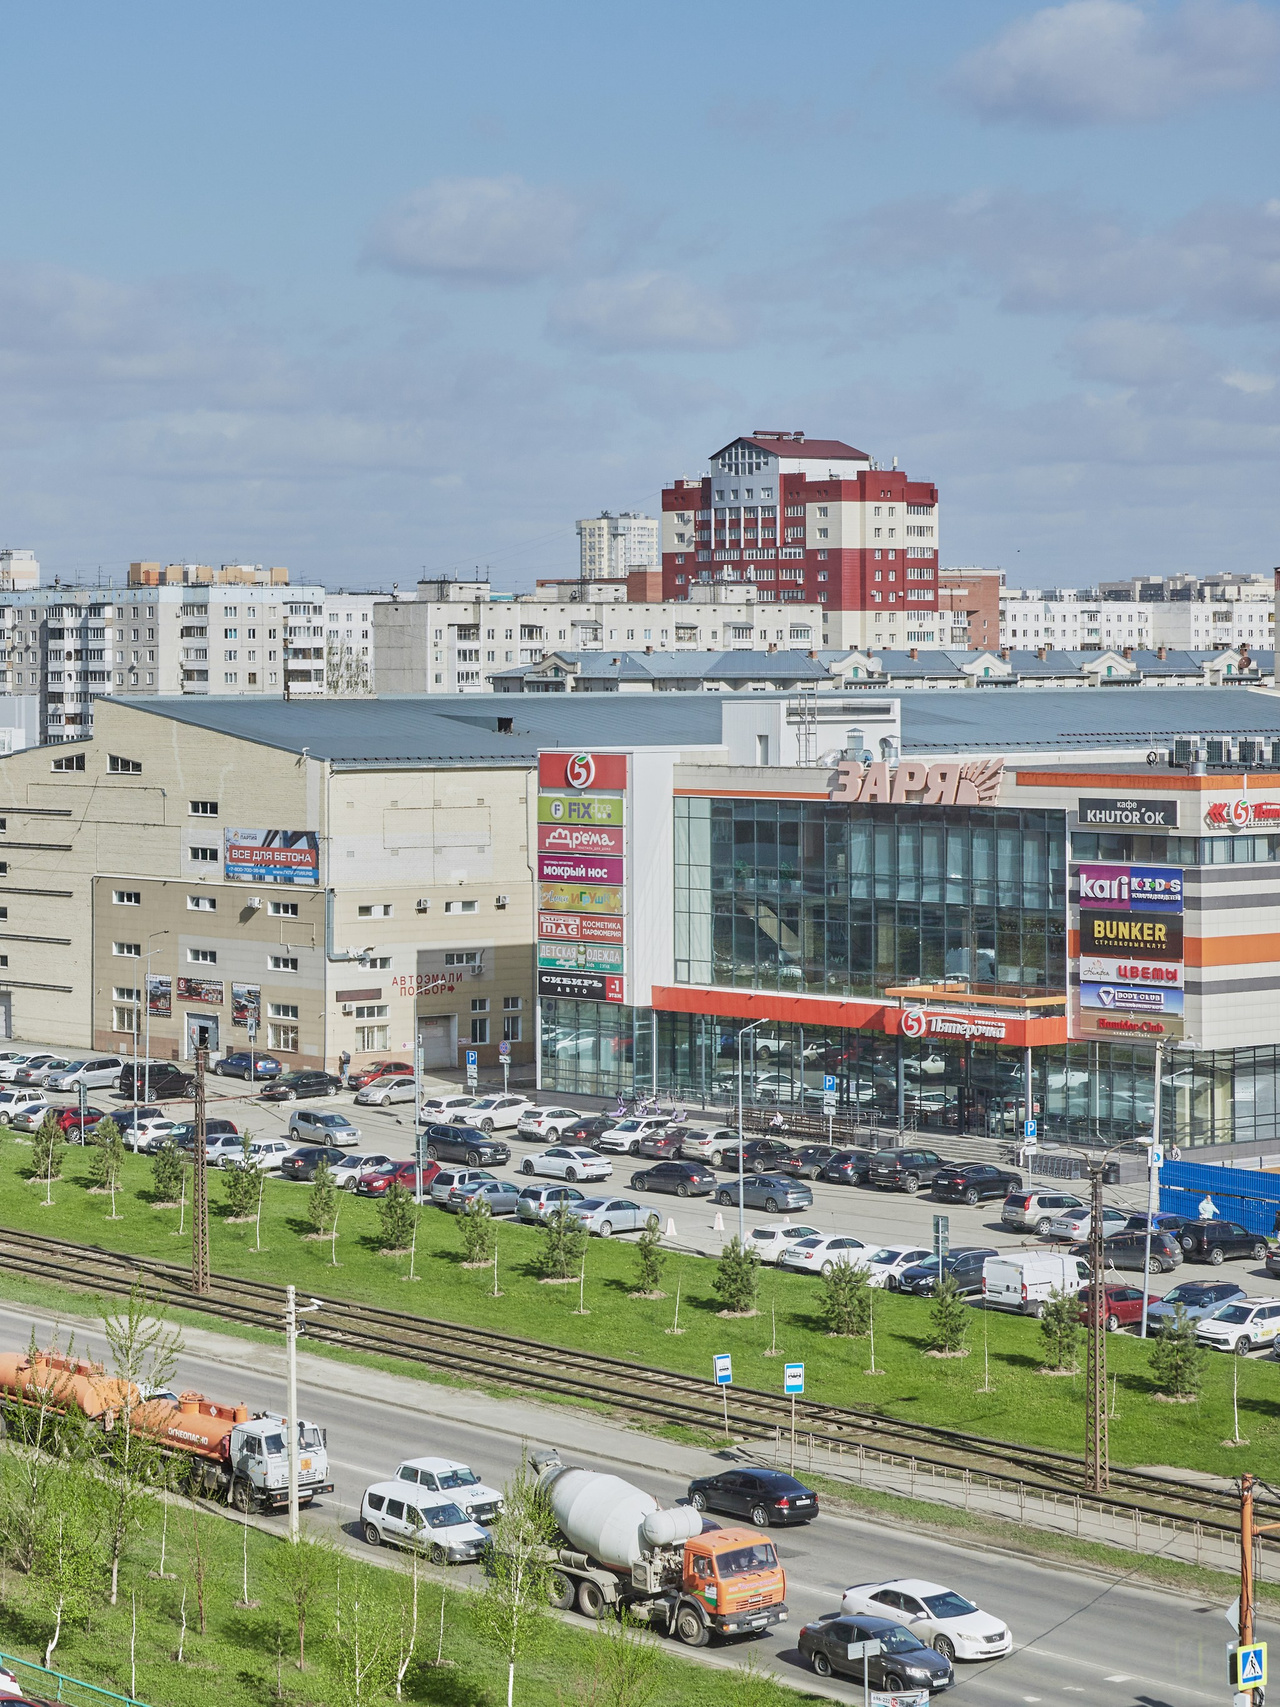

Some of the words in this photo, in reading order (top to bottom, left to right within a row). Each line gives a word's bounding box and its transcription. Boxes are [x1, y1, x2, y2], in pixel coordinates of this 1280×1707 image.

[832, 761, 960, 804] ЗАРЯ
[1116, 800, 1137, 810] кафе
[232, 849, 251, 859] ВСЕ
[252, 851, 273, 861] ДЛЯ
[274, 853, 312, 862] БЕТОНА
[588, 868, 608, 878] нос
[1080, 874, 1129, 899] kari
[582, 921, 622, 930] КОСМЕТИКА
[1093, 920, 1167, 942] BUNKER
[582, 929, 622, 938] ПАРФЮМЕРИЯ
[1095, 940, 1144, 948] СТРЕЛКОВЫЙ
[540, 945, 576, 958] ДЕТСКАЯ
[586, 949, 620, 962] ОДЕЖДА
[392, 972, 463, 986] АВТОЭМАЛИ
[542, 976, 603, 988] СИБИРЬ
[400, 985, 446, 996] ПОДБОР
[611, 980, 619, 992] -1
[1118, 992, 1138, 1000] BODY
[1140, 993, 1161, 1001] CLUB
